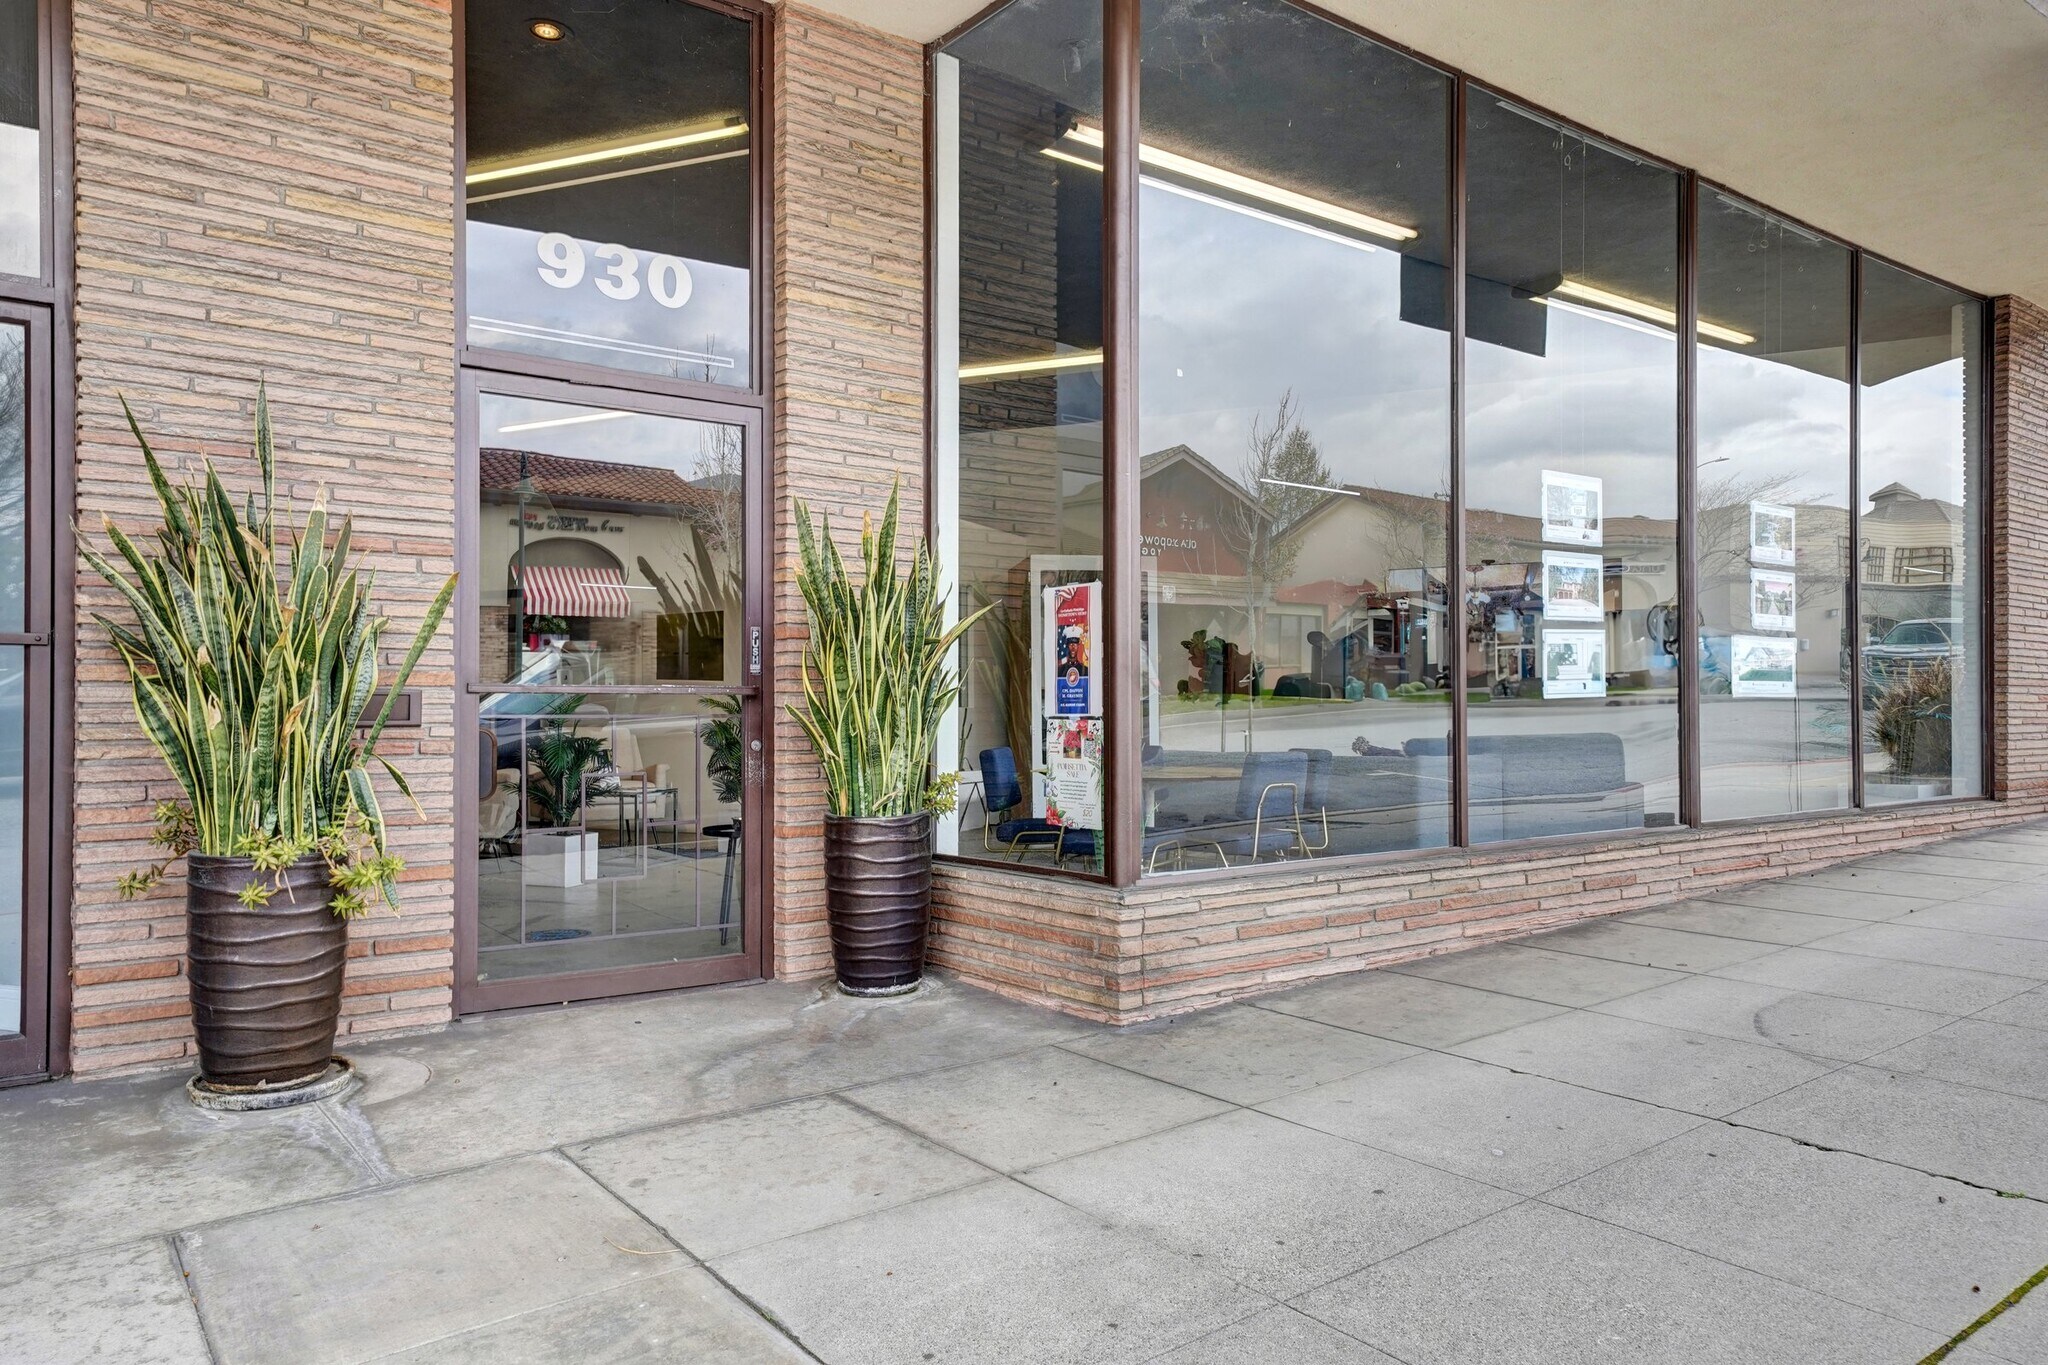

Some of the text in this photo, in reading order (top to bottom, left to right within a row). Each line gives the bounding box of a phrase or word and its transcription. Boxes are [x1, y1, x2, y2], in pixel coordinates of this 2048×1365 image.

[537, 232, 693, 309] 930
[1066, 770, 1080, 778] SALE
[1082, 809, 1093, 817] $20
